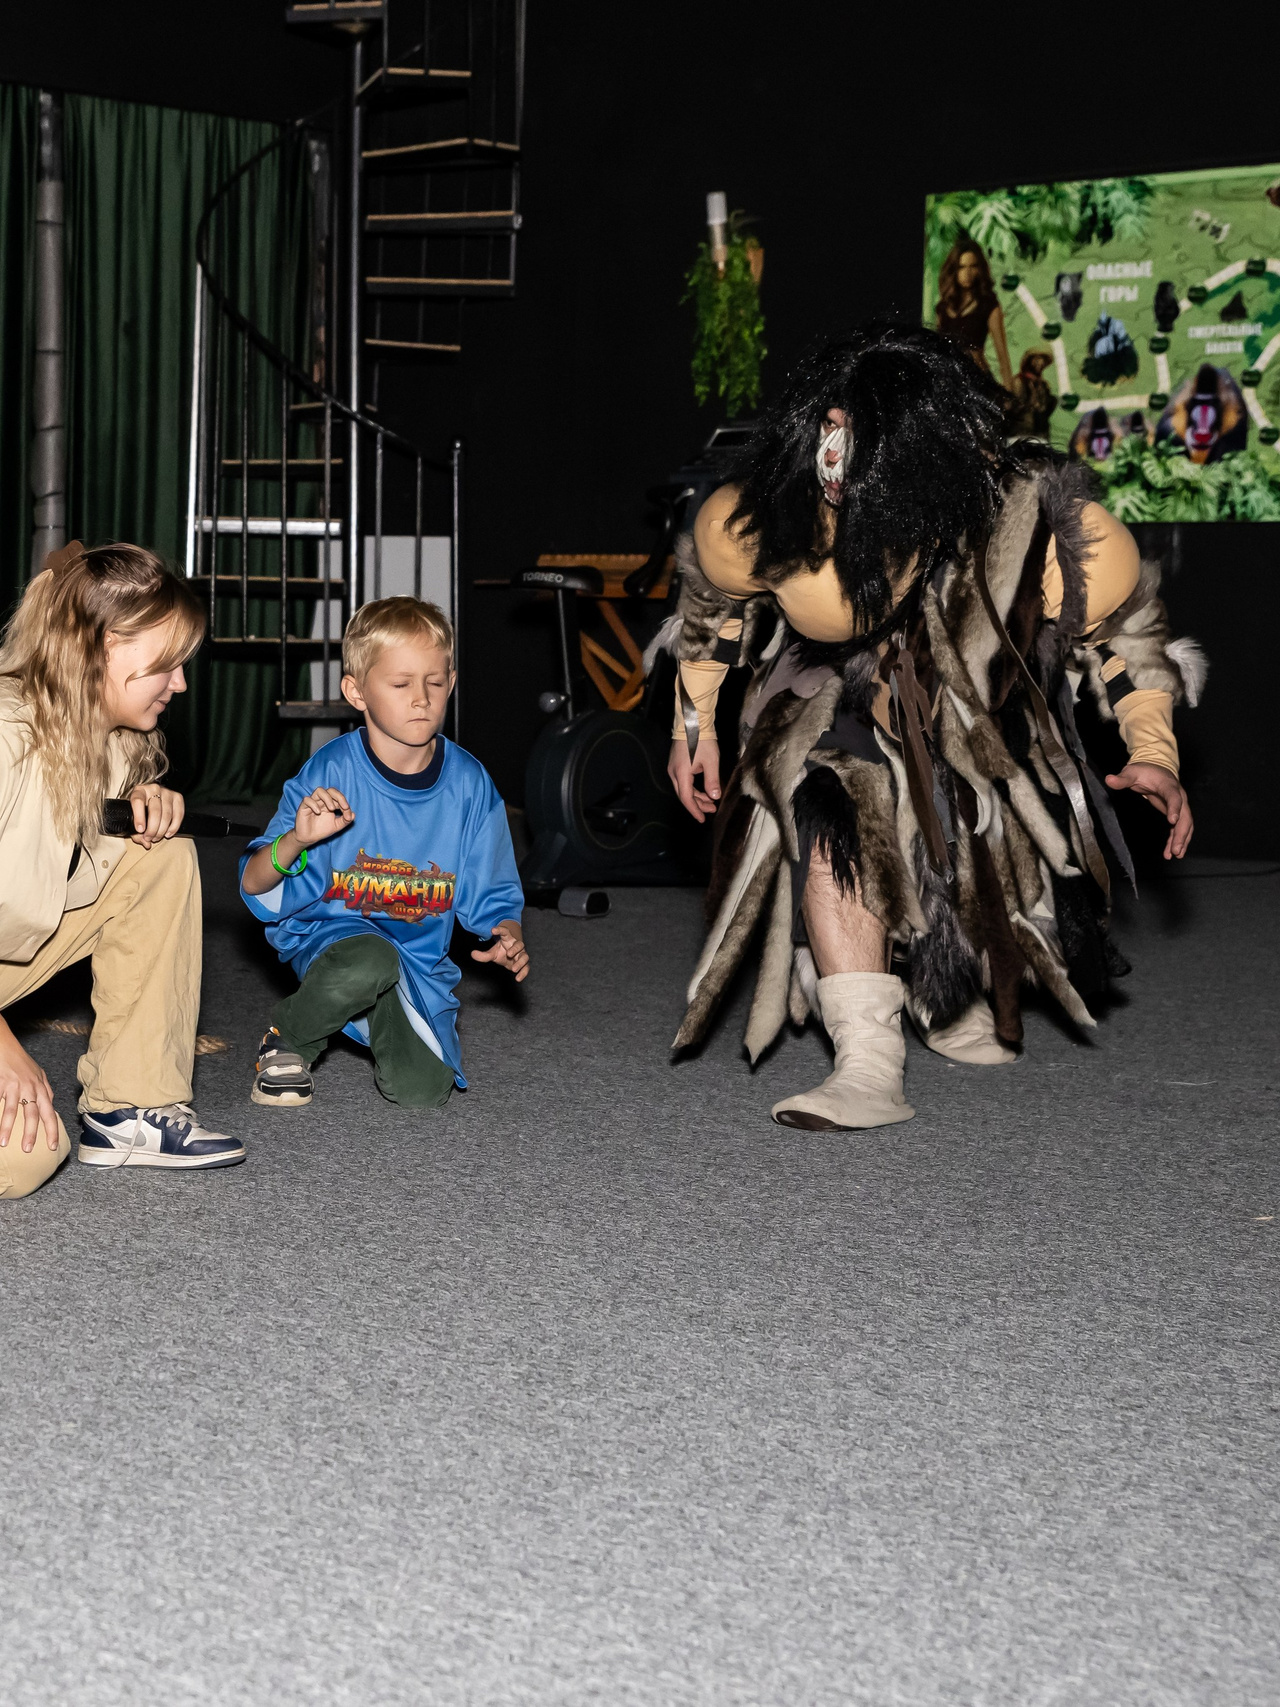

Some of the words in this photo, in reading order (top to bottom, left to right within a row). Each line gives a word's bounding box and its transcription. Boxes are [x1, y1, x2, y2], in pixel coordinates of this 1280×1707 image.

[522, 571, 564, 583] TORNEO
[362, 861, 413, 876] ИГРОВОЕ
[394, 906, 423, 917] ШОУ
